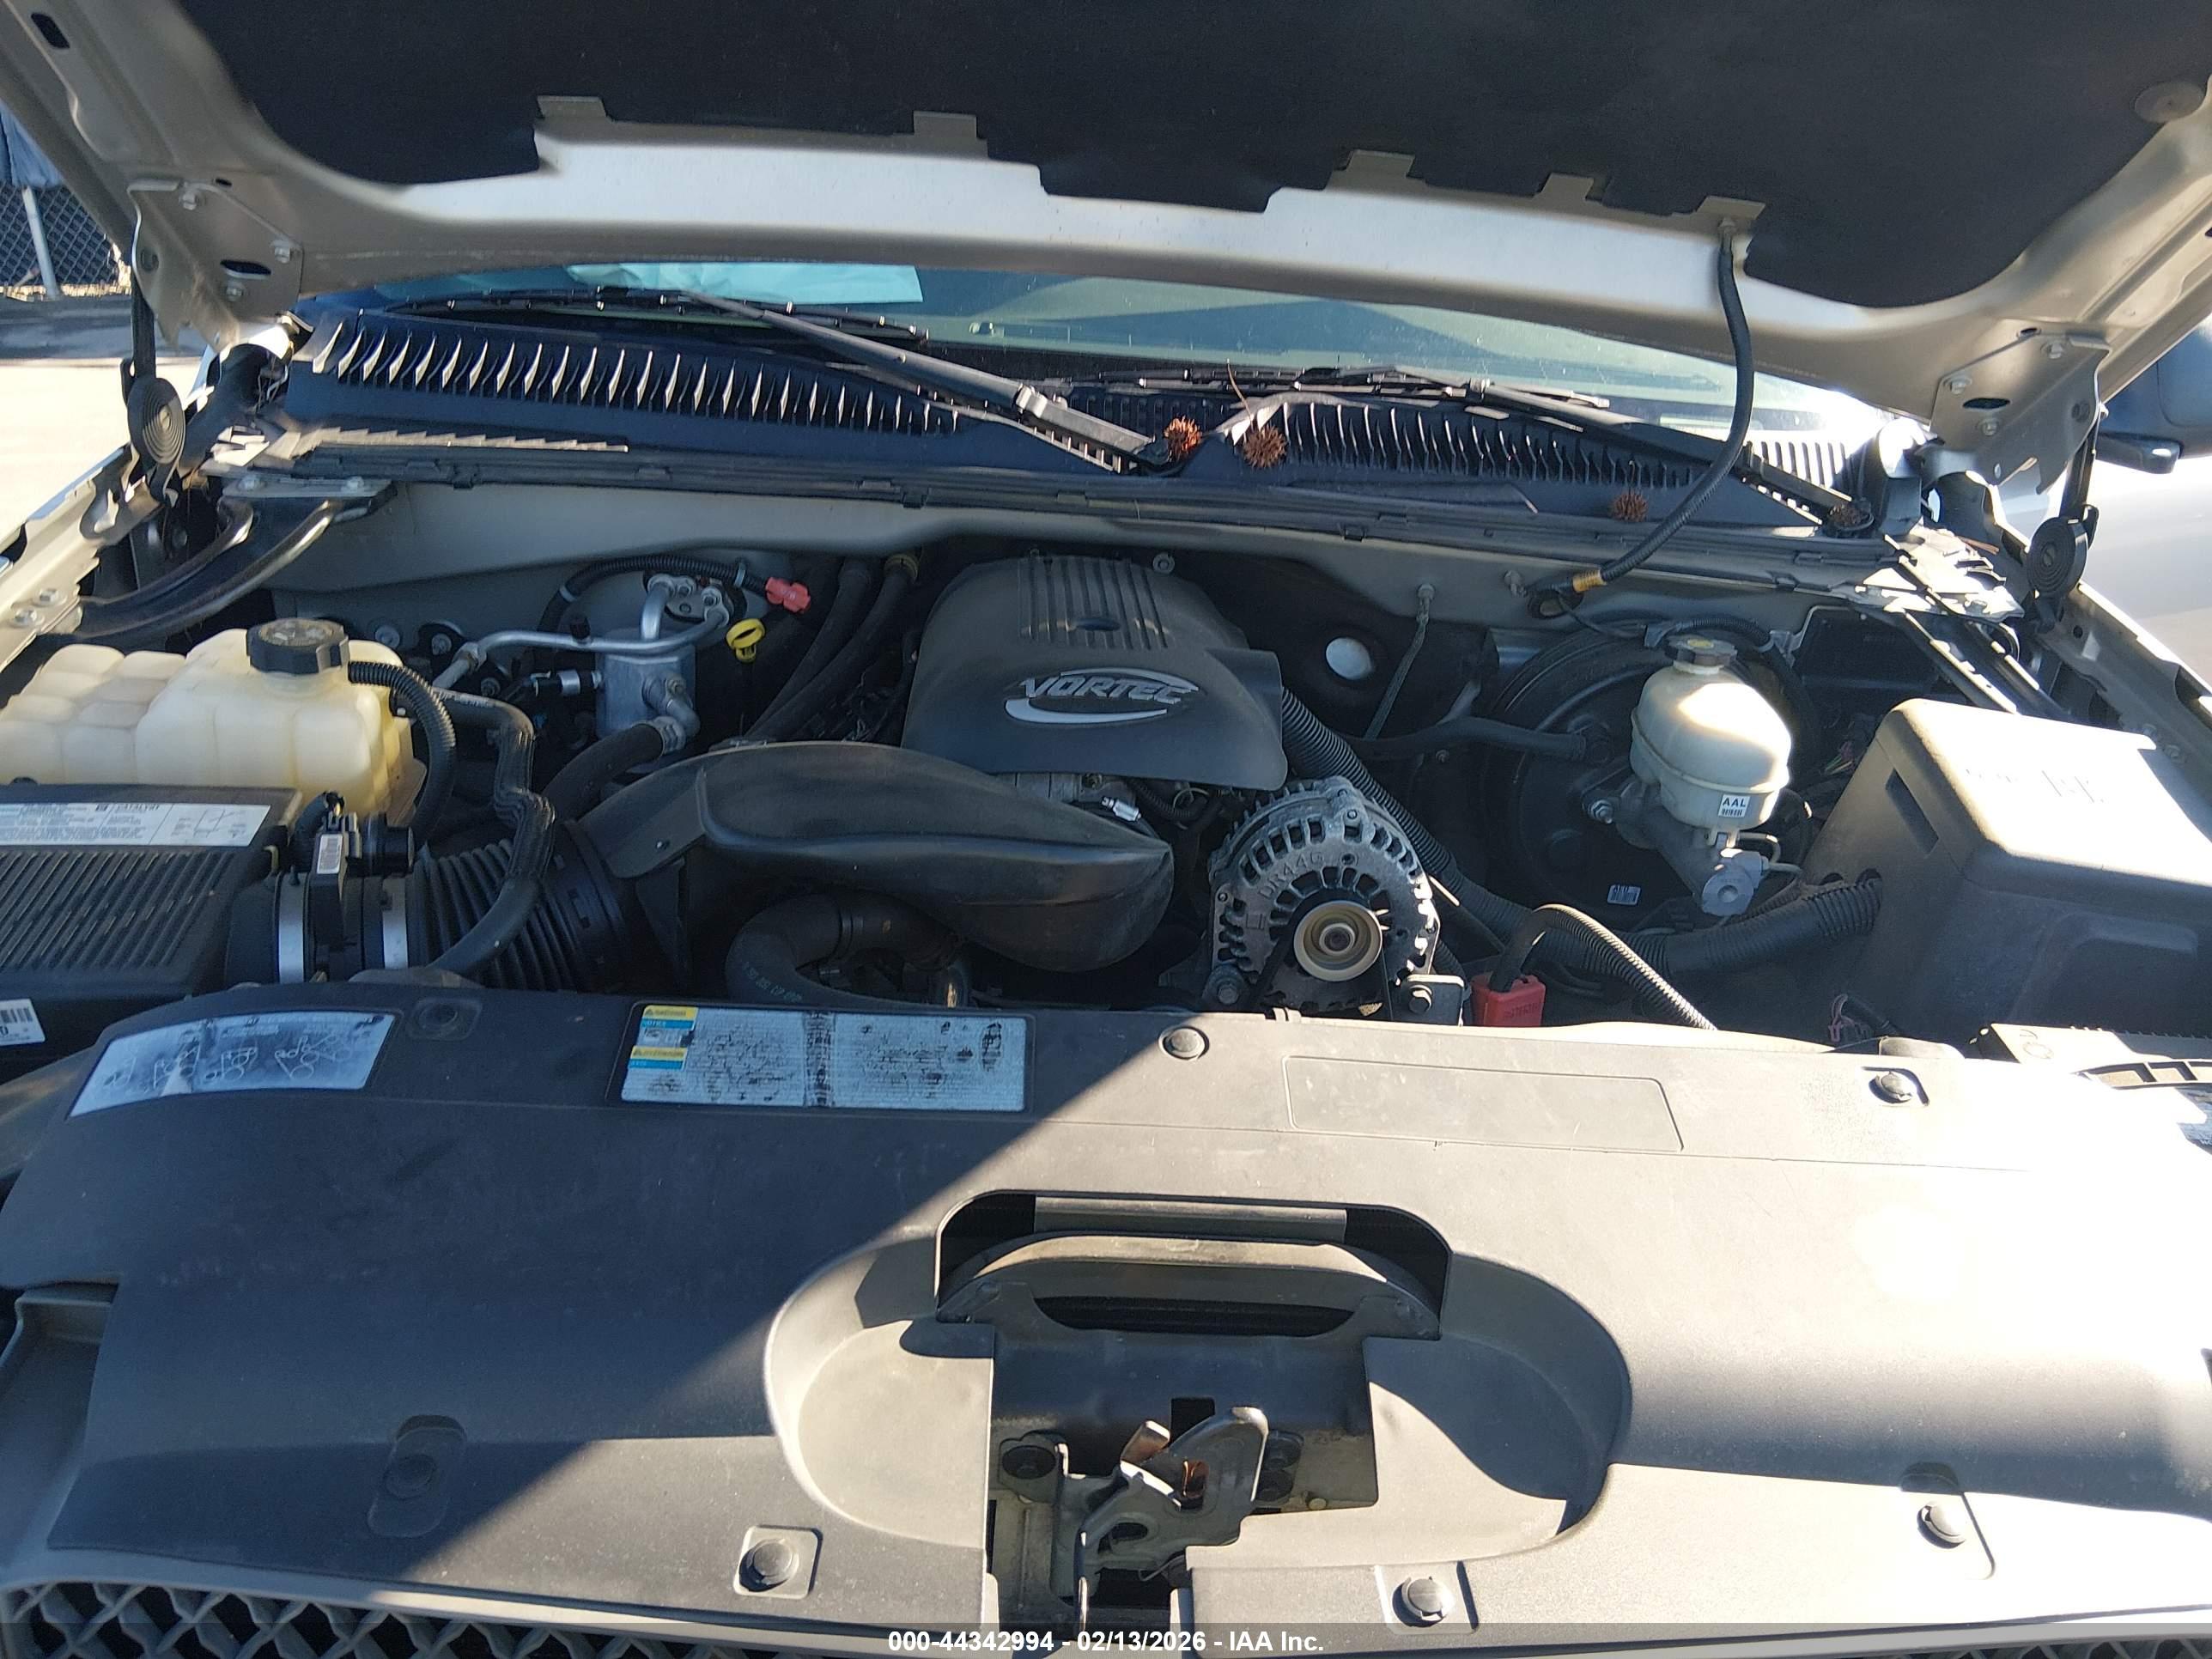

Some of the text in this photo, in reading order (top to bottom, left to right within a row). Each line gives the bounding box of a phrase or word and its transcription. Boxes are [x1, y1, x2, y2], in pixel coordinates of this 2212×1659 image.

[1018, 675, 1192, 705] VORTEC
[1723, 798, 1746, 807] AAL
[1258, 851, 1324, 899] DR44G
